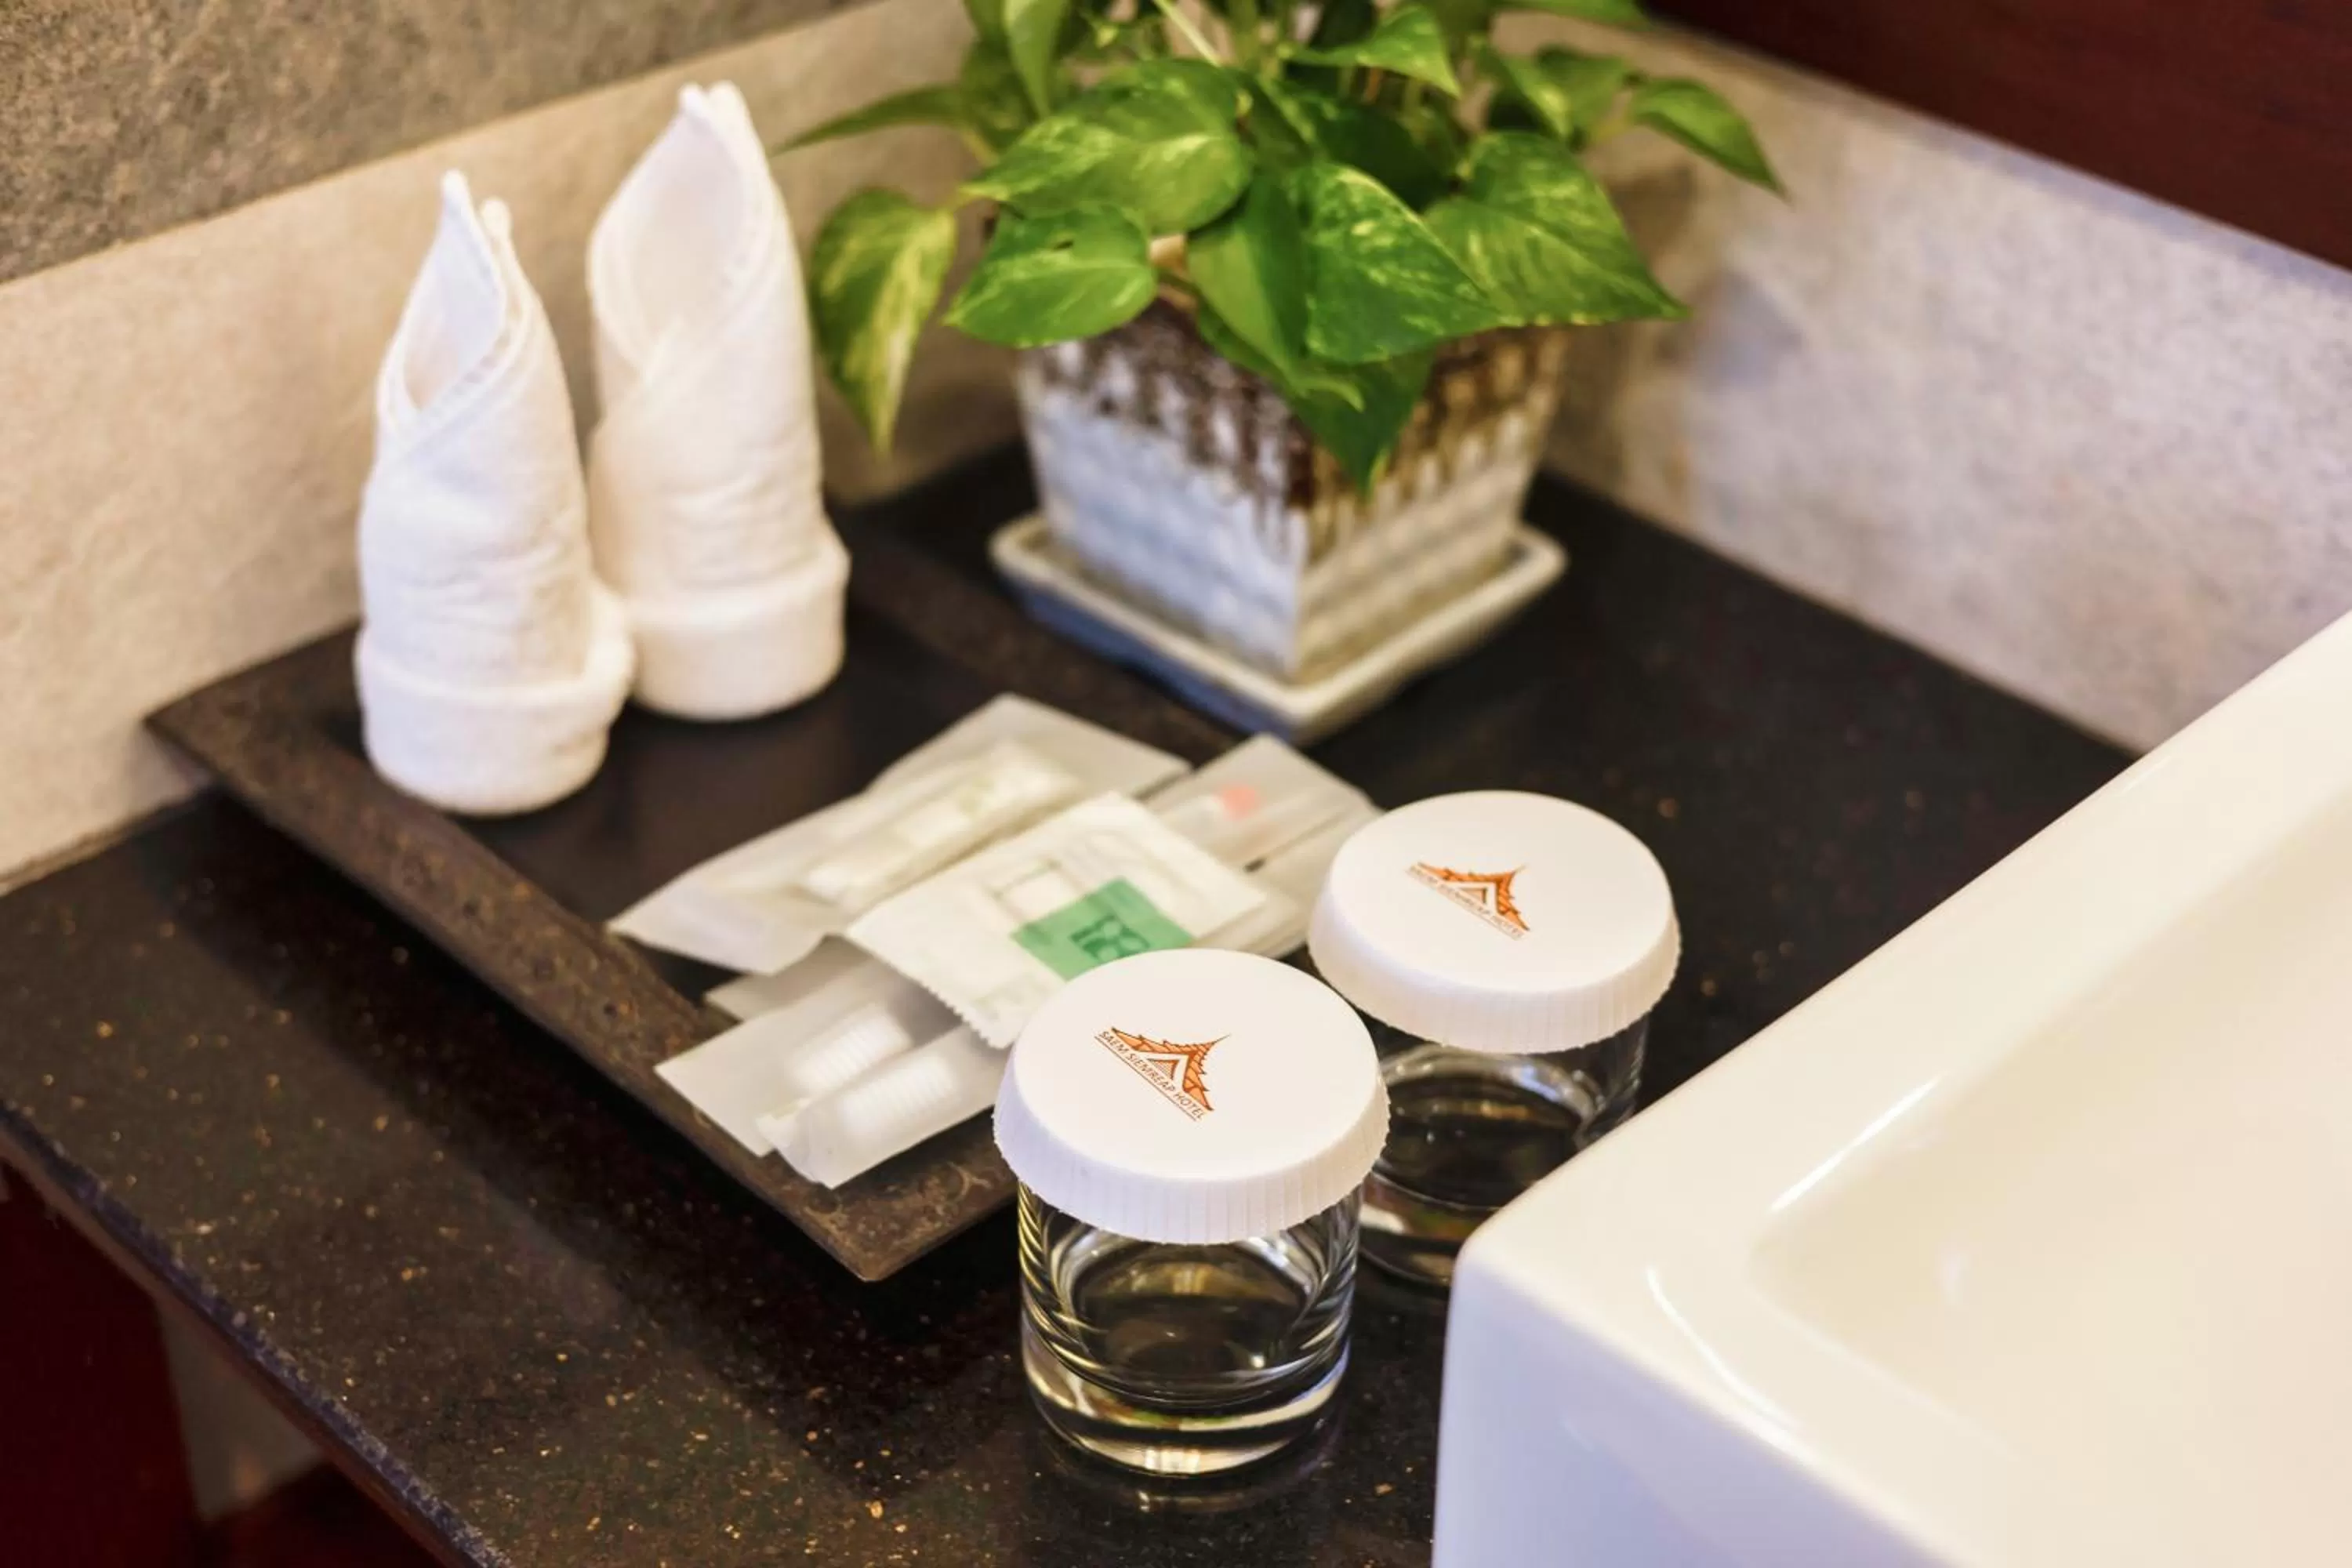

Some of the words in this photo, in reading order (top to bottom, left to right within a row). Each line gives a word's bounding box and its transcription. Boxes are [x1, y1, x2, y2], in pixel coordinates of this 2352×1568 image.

[1099, 1030, 1130, 1057] SAEM
[1127, 1053, 1175, 1092] SIEMREAP
[1174, 1091, 1206, 1120] HOTEL
